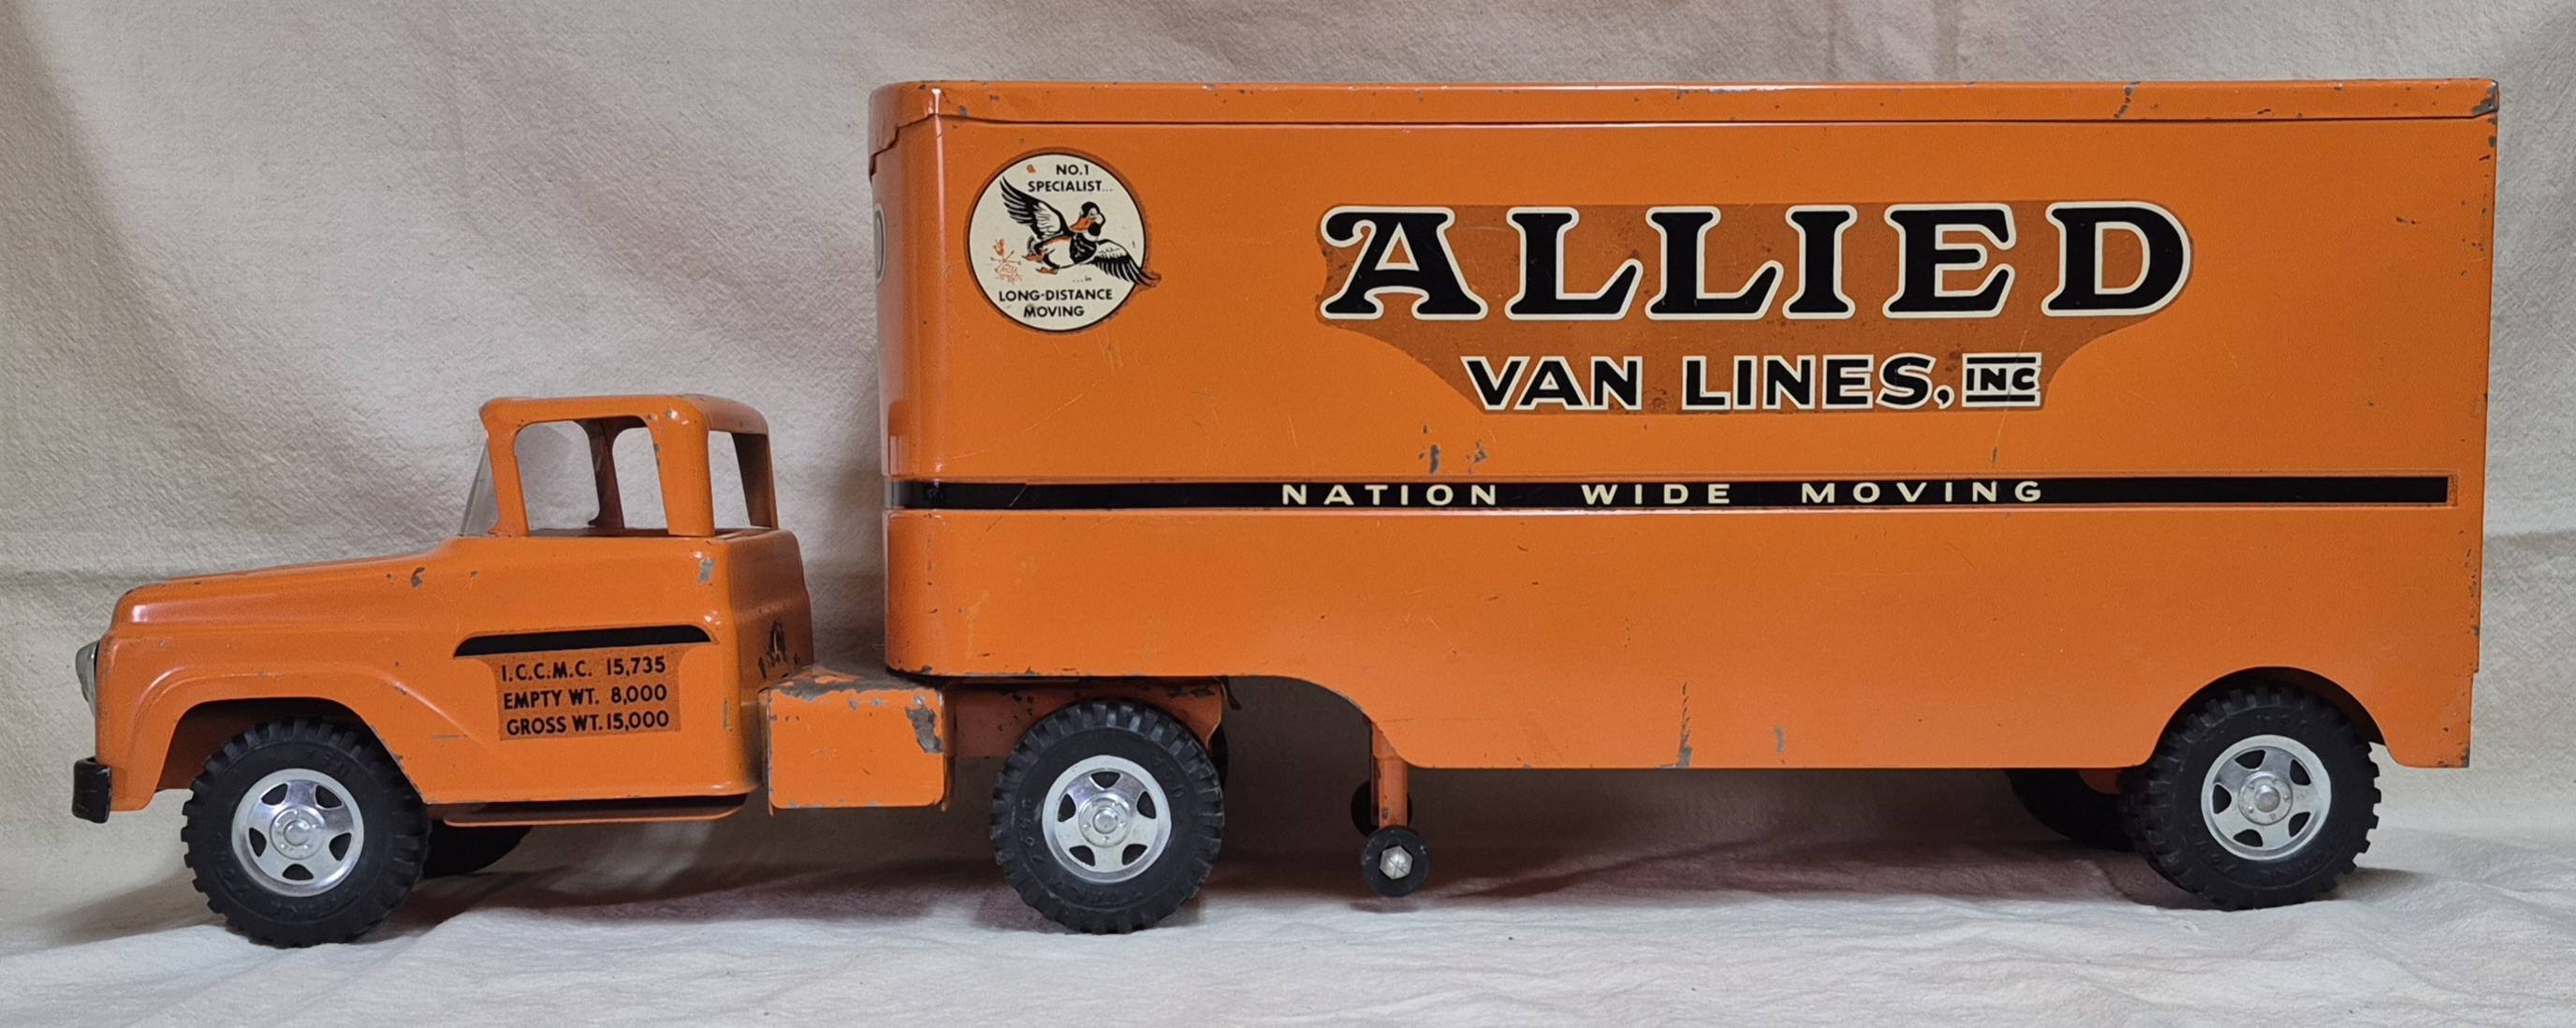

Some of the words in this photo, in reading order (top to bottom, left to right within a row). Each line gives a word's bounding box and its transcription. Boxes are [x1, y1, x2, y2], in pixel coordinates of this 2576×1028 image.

[1056, 164, 1089, 175] NO.1
[1321, 202, 2190, 320] ALLIED
[999, 288, 1113, 301] LONG-DISTANCE
[1023, 305, 1085, 317] MOVING
[1460, 354, 1642, 412] VAN
[1681, 353, 1954, 410] LINES,
[1962, 363, 2041, 393] INC
[1281, 484, 1498, 506] NATION
[1581, 482, 1732, 506] WIDE
[1801, 480, 2043, 505] MOVING
[502, 661, 593, 683] I.C.C.M.C.
[606, 656, 666, 677] 15,735
[503, 691, 562, 710] EMPTY
[568, 688, 599, 706] WT.
[610, 684, 667, 705] 8,000
[505, 716, 567, 736] GROSS
[572, 714, 603, 732] WT.
[607, 711, 669, 731] 15,000
